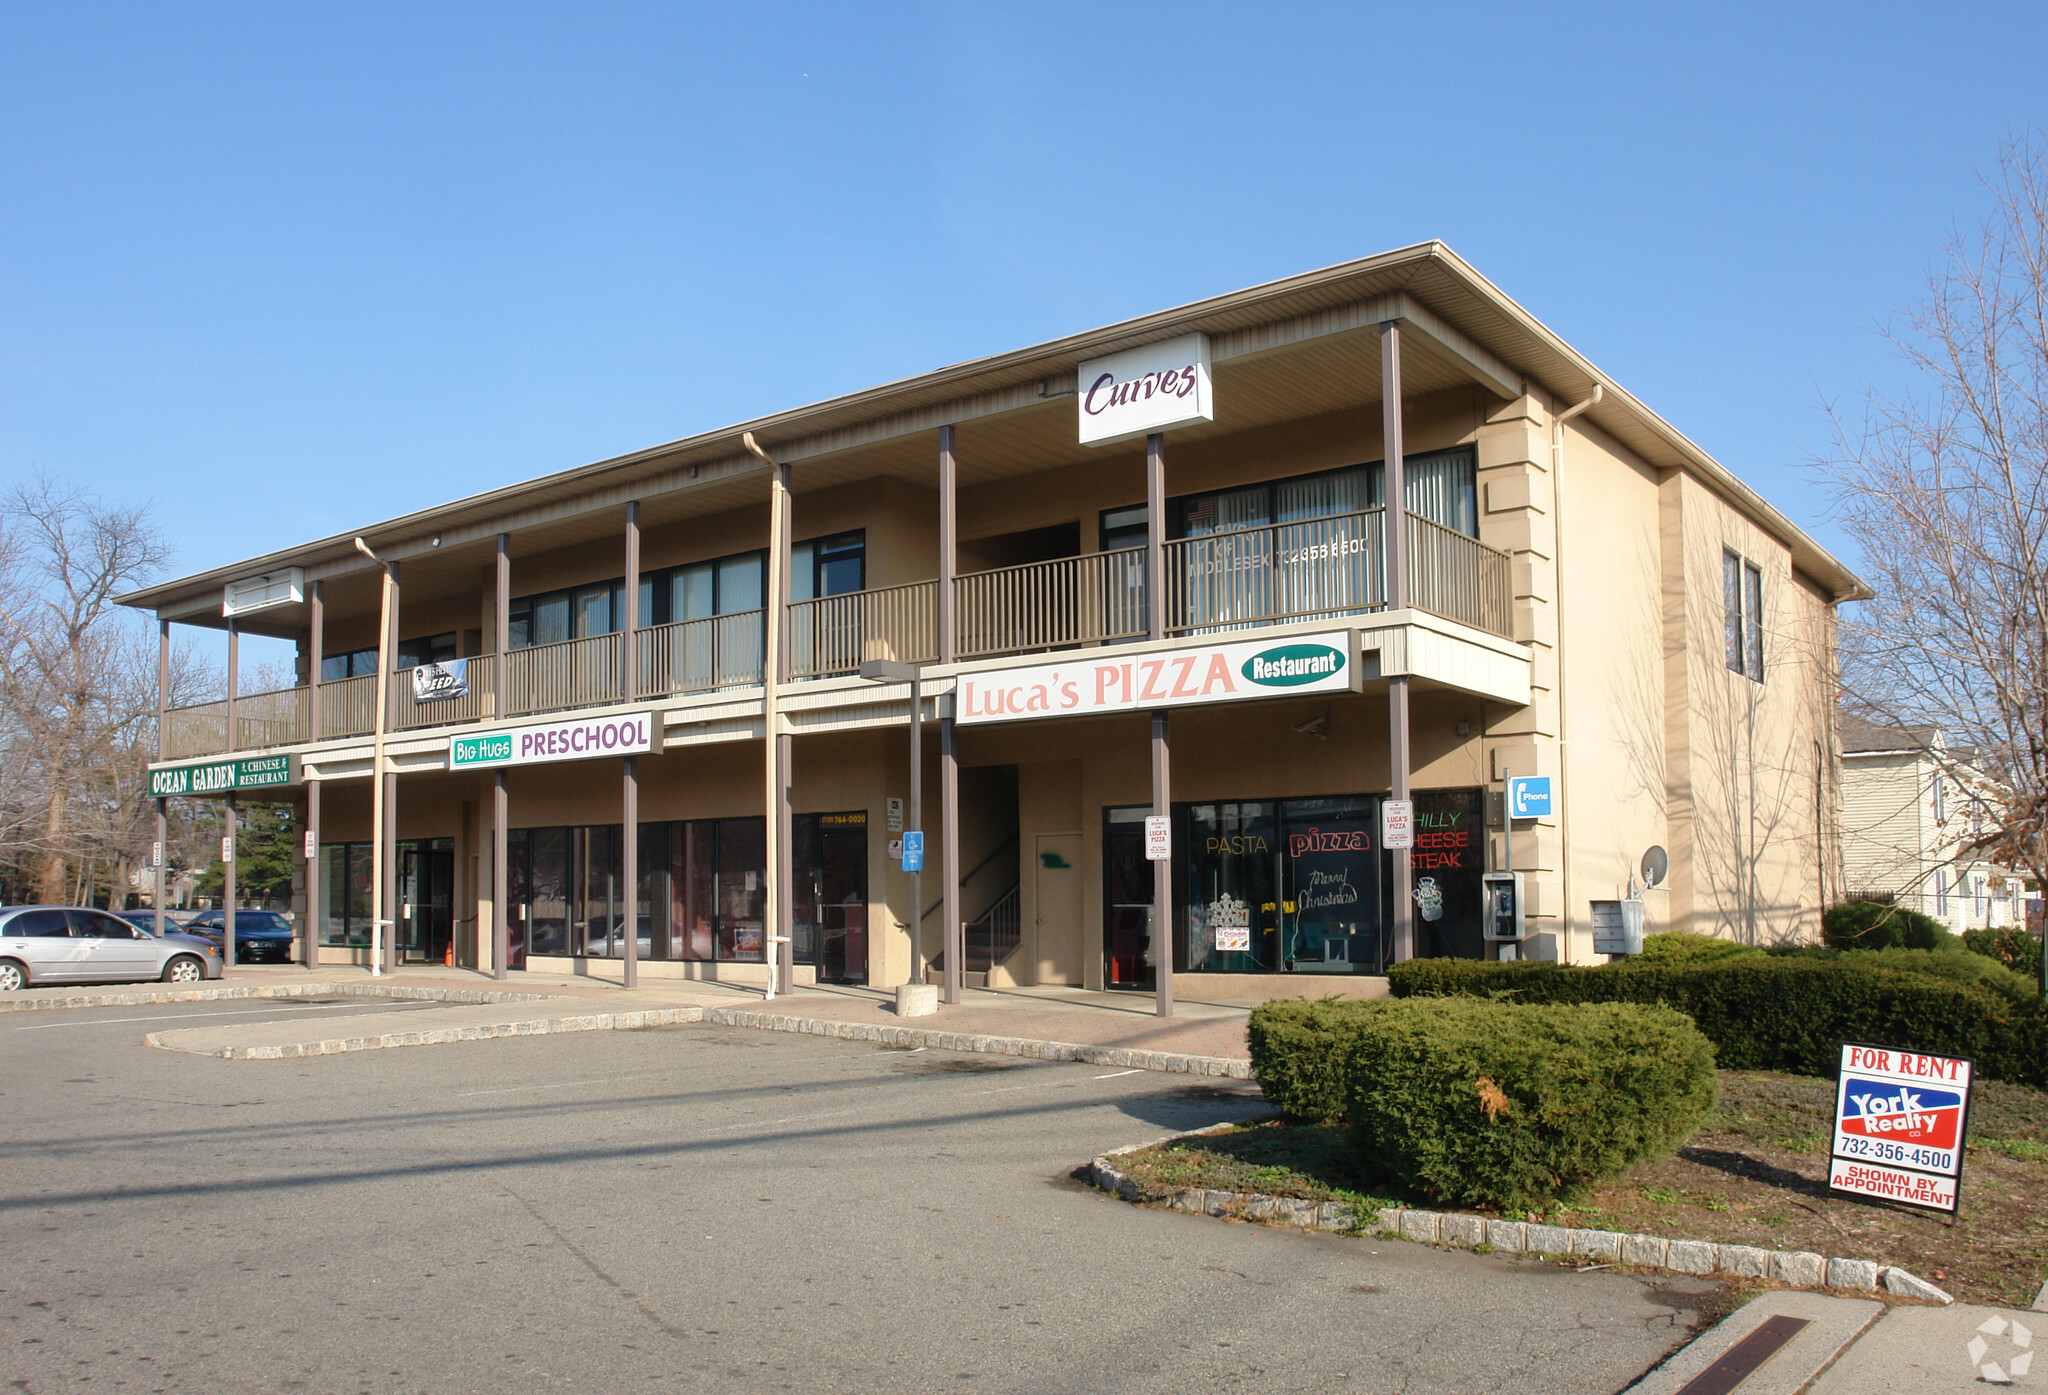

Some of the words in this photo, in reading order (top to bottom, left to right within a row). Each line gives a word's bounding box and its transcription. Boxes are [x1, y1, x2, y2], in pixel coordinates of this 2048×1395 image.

[1085, 365, 1195, 415] Curves
[1189, 553, 1270, 577] MIDDLESEX
[1252, 649, 1338, 680] Restaurant
[963, 672, 1080, 717] Luca's
[1093, 652, 1239, 706] PIZZA
[521, 720, 648, 757] PRESCHOOL
[247, 758, 281, 772] CHINESE
[153, 770, 188, 794] OCEAN
[193, 763, 236, 791] GARDEN
[239, 771, 288, 786] RESTAURANT
[1523, 792, 1548, 801] Phone
[1386, 815, 1408, 823] LUCA'S
[1389, 822, 1406, 830] PIZZA
[1412, 811, 1462, 828] HILLY
[1206, 836, 1268, 855] PASTA
[1412, 831, 1469, 849] HEESE
[1309, 868, 1348, 886] Merry
[1850, 1047, 1891, 1072] FOR
[1898, 1053, 1963, 1081] RENT
[1850, 1088, 1925, 1114] York
[1864, 1111, 1938, 1134] Realty
[1841, 1137, 1952, 1169] 732-356-4500
[1832, 1174, 1954, 1206] APPOINTMENT
[1848, 1166, 1910, 1187] SHOWN
[1916, 1178, 1939, 1191] BY
